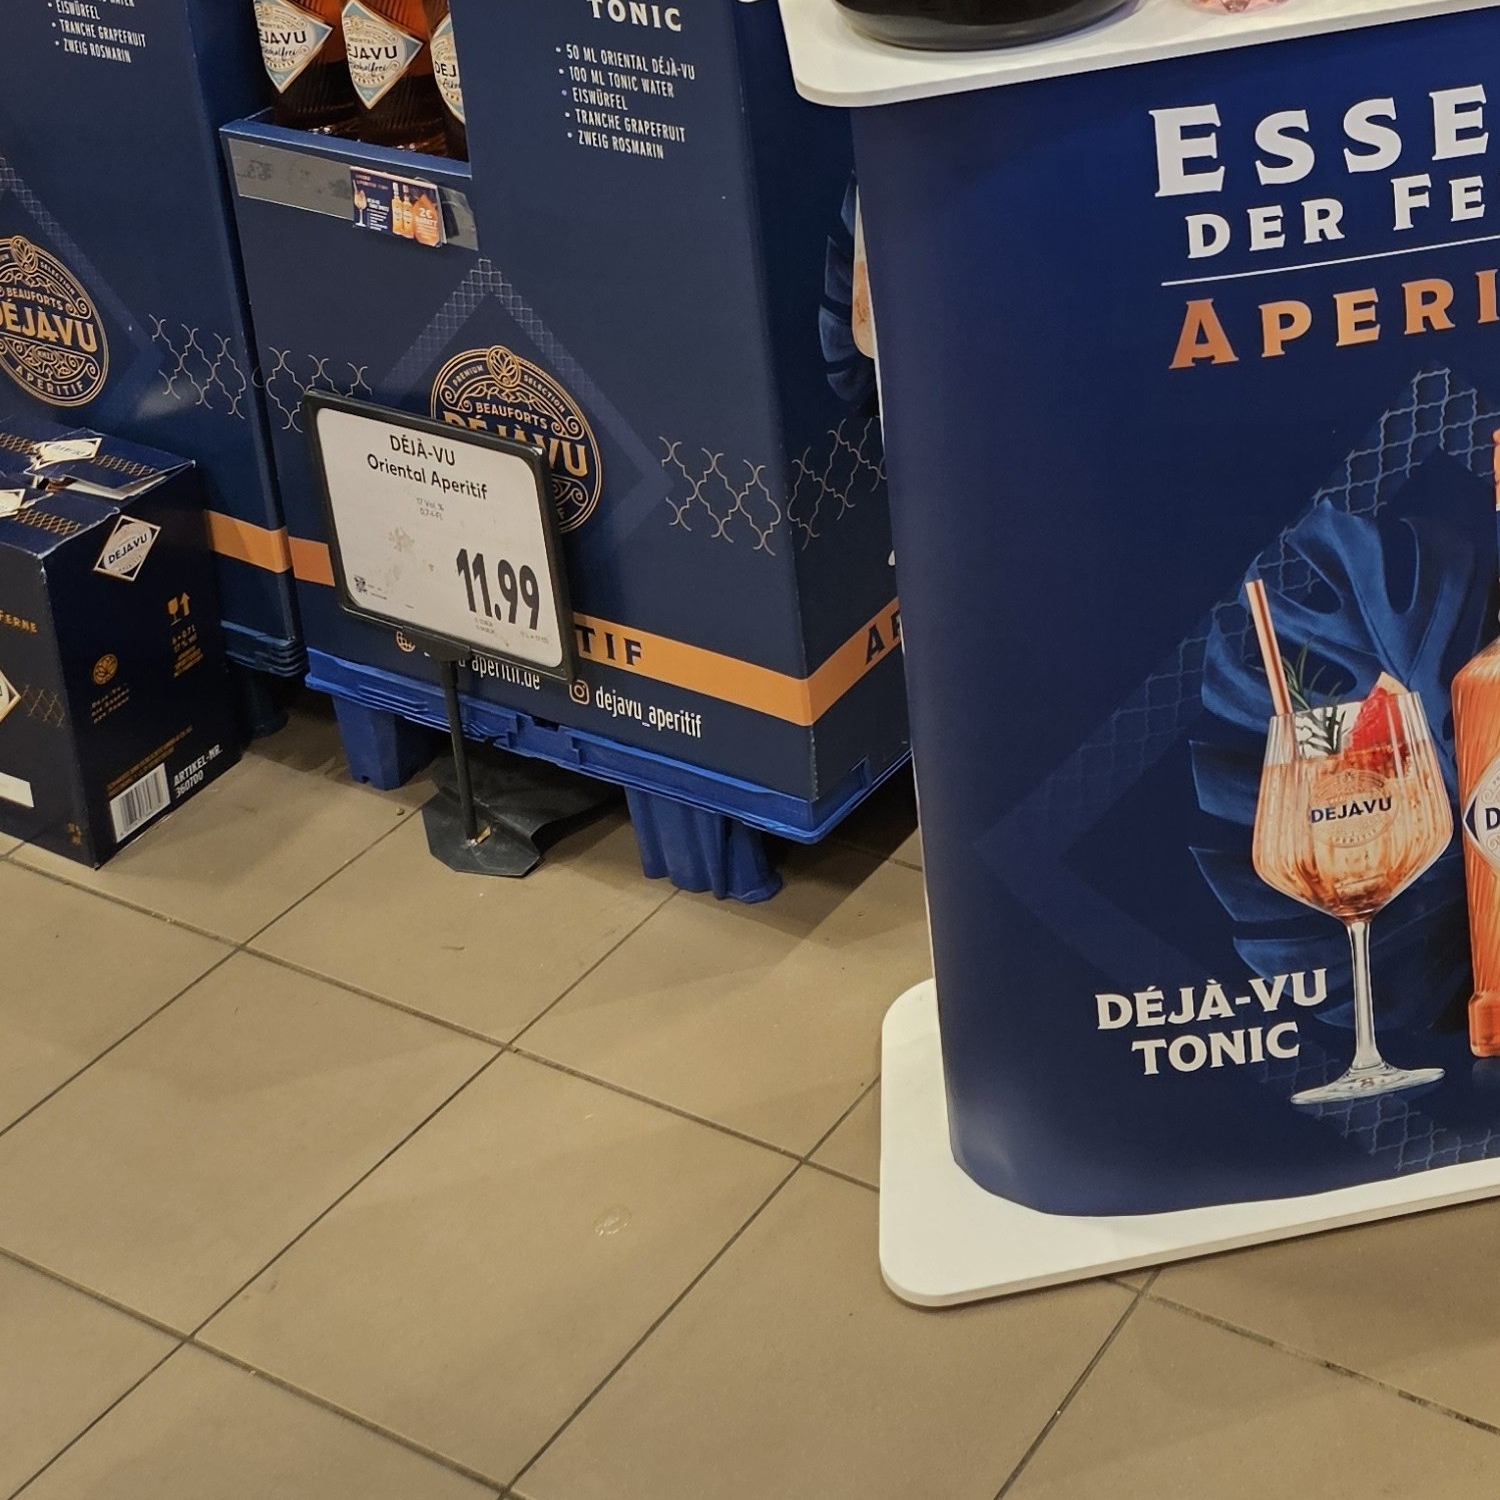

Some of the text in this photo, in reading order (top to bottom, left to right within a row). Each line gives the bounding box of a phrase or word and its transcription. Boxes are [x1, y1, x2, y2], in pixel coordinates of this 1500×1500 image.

[55, 0, 101, 20] EISWÜRFEL
[59, 18, 147, 48] TRANCHE GRAPEFRUIT
[63, 38, 132, 64] ZWEIG ROSMARIN
[565, 43, 696, 81] 50 ML ORIENTAL DÉJÀ-VU
[569, 66, 675, 99] 100 ML TONIC WATER
[572, 86, 629, 111] EISWÜRFEL
[575, 108, 686, 143] TRANCHE GRAPEFRUIT
[577, 129, 665, 160] ZWEIG ROSMARIN
[1186, 197, 1346, 260] DER
[6, 287, 64, 311] BEAUFORTS
[15, 364, 85, 397] APERITIF
[452, 364, 484, 387] PREMIUM
[475, 401, 549, 430] BEAUFORTS
[389, 434, 456, 467] DÉJÀ-VU
[366, 453, 488, 501] Oriental Aperitif
[456, 548, 540, 631] 11.99
[595, 685, 703, 739] dejavu_aperitif
[173, 743, 224, 787] ARTIKEL-NR.
[174, 770, 205, 799] 360700
[1095, 967, 1330, 1033] DÉJÀ-VU
[1130, 1021, 1301, 1078] TONIC
